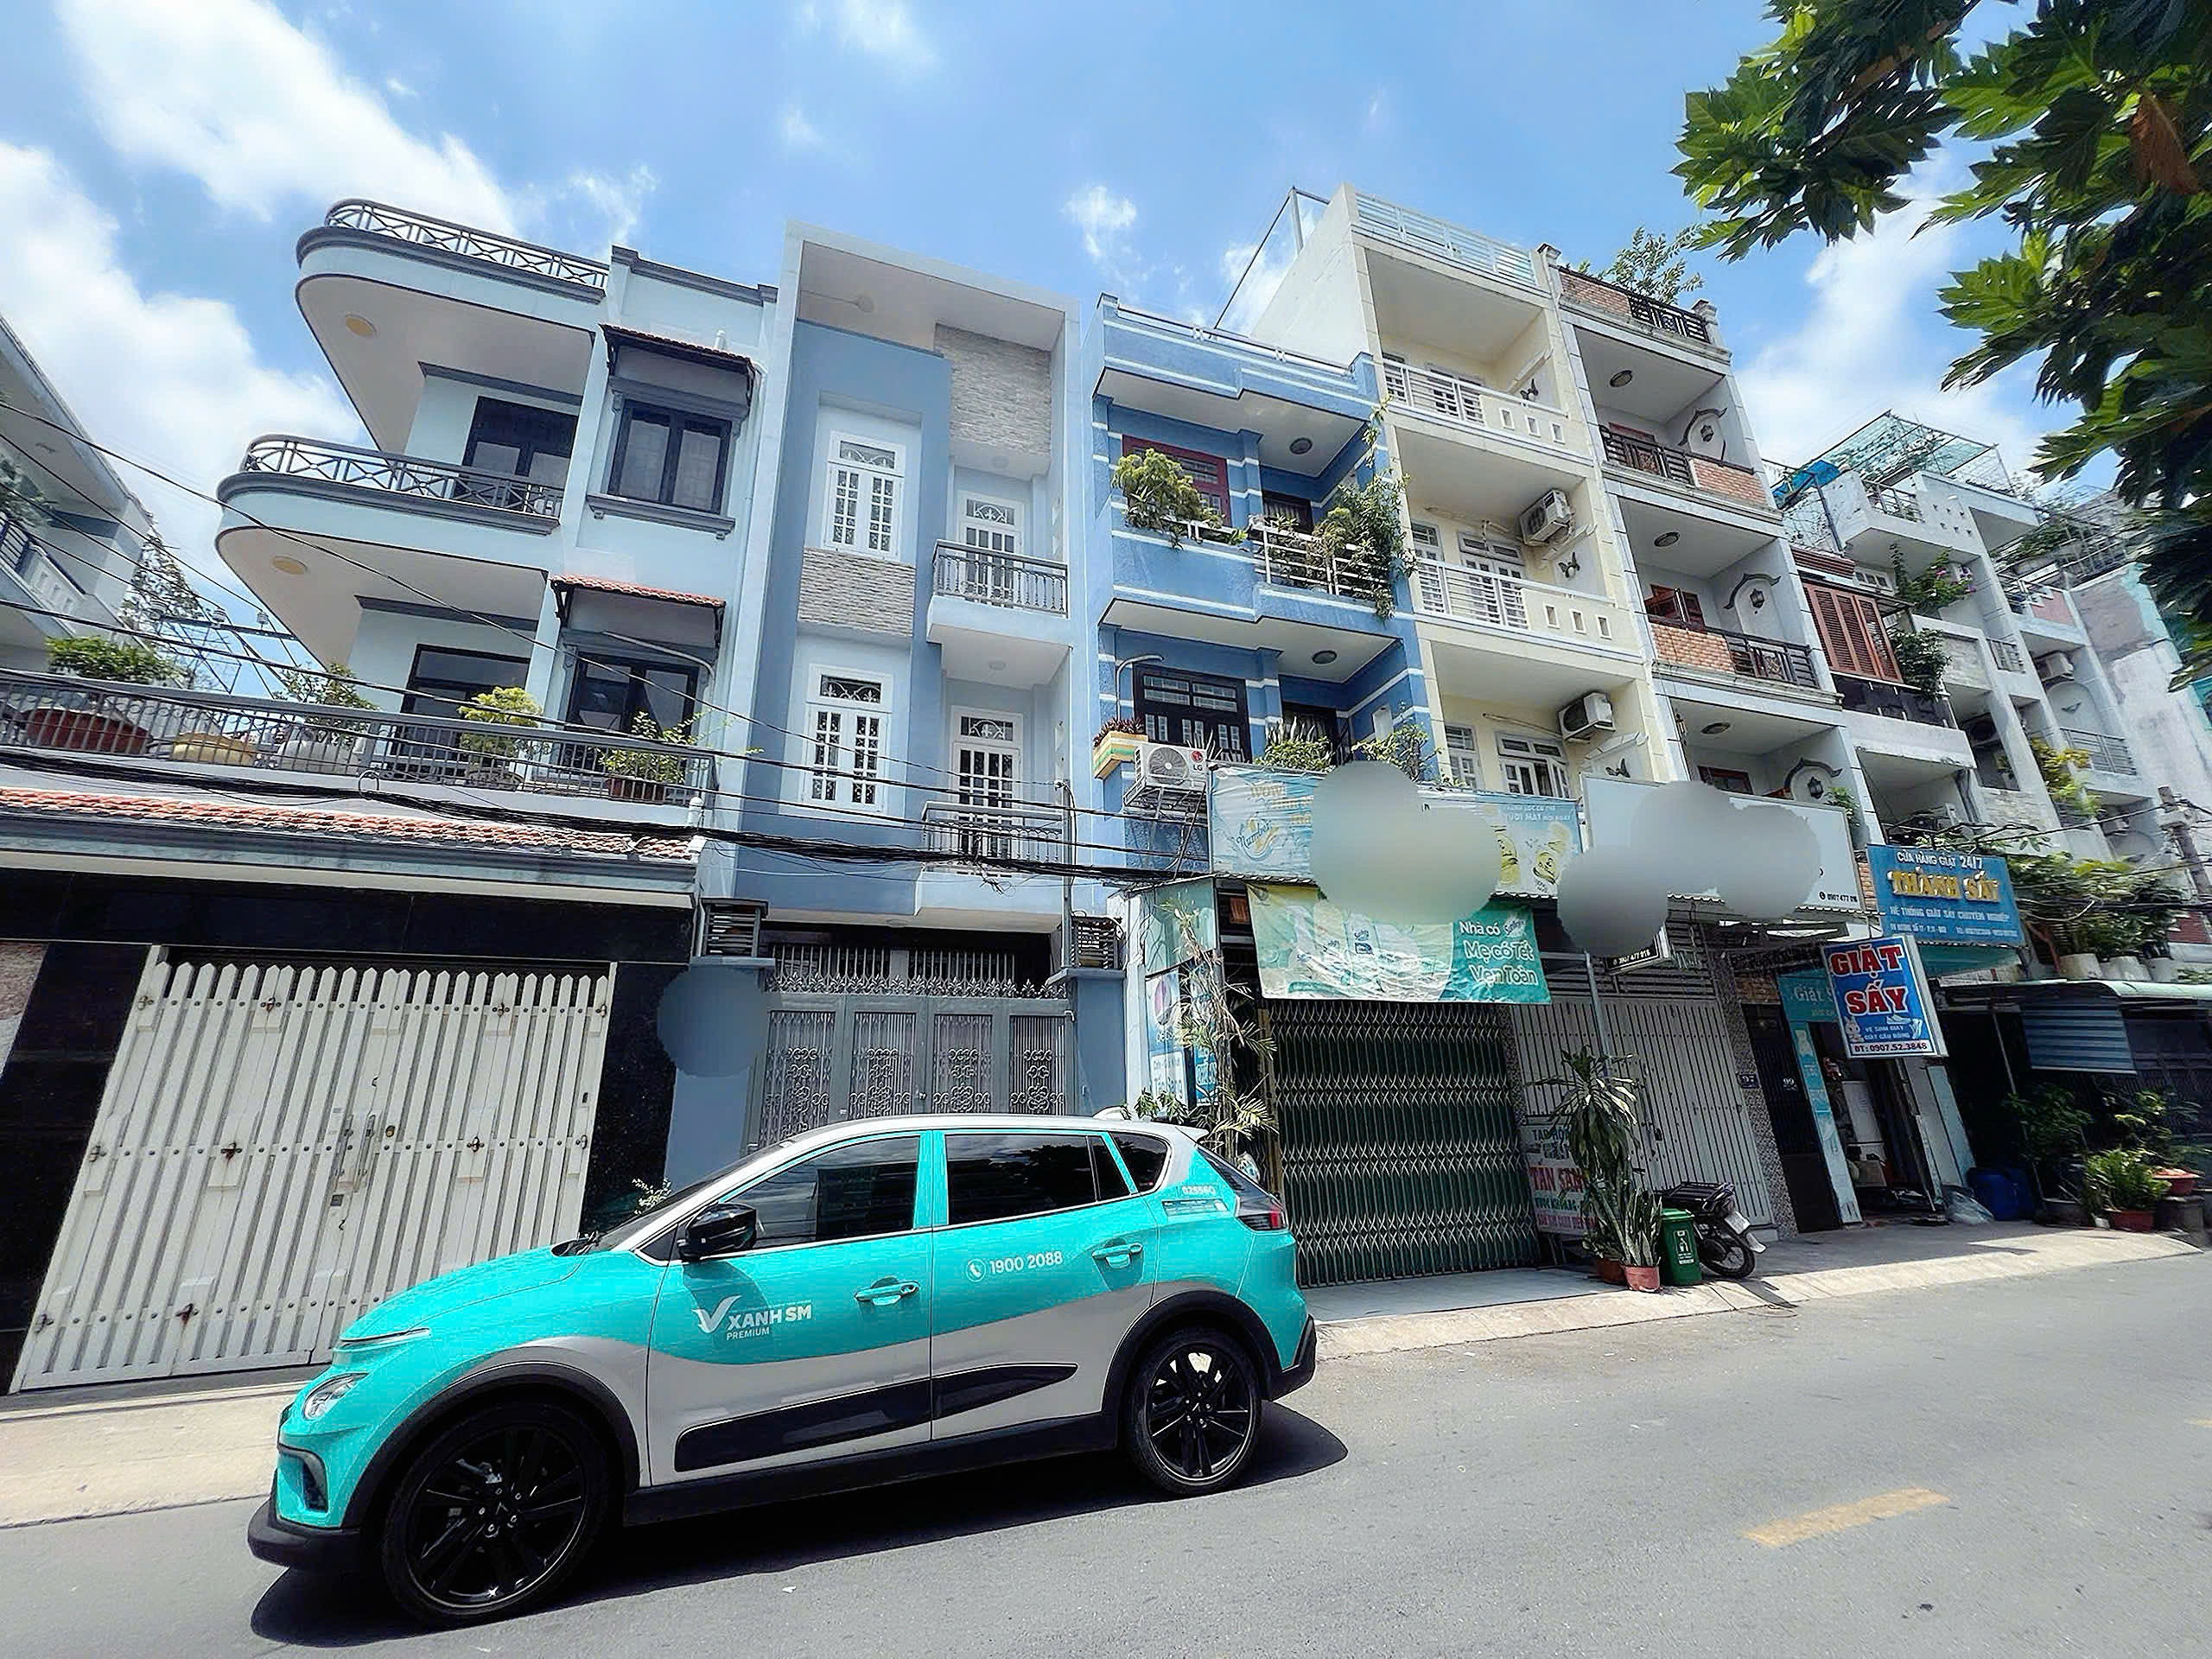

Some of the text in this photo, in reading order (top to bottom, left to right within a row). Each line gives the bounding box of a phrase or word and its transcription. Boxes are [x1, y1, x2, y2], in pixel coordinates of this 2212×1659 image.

[1916, 853, 1937, 865] HÀNG
[1959, 855, 1983, 870] 24/7
[1459, 920, 1484, 935] Nhà
[1486, 923, 1501, 936] có
[1463, 939, 1535, 963] Mẹ có Tết
[1830, 944, 1905, 979] GIẶT
[1468, 963, 1538, 988] Vẹn Toàn
[1845, 979, 1909, 1015] SẤY
[989, 1250, 1064, 1274] 1900 2088
[728, 1308, 782, 1331] XANH
[785, 1304, 812, 1322] SM
[726, 1326, 770, 1341] PREMIUM
